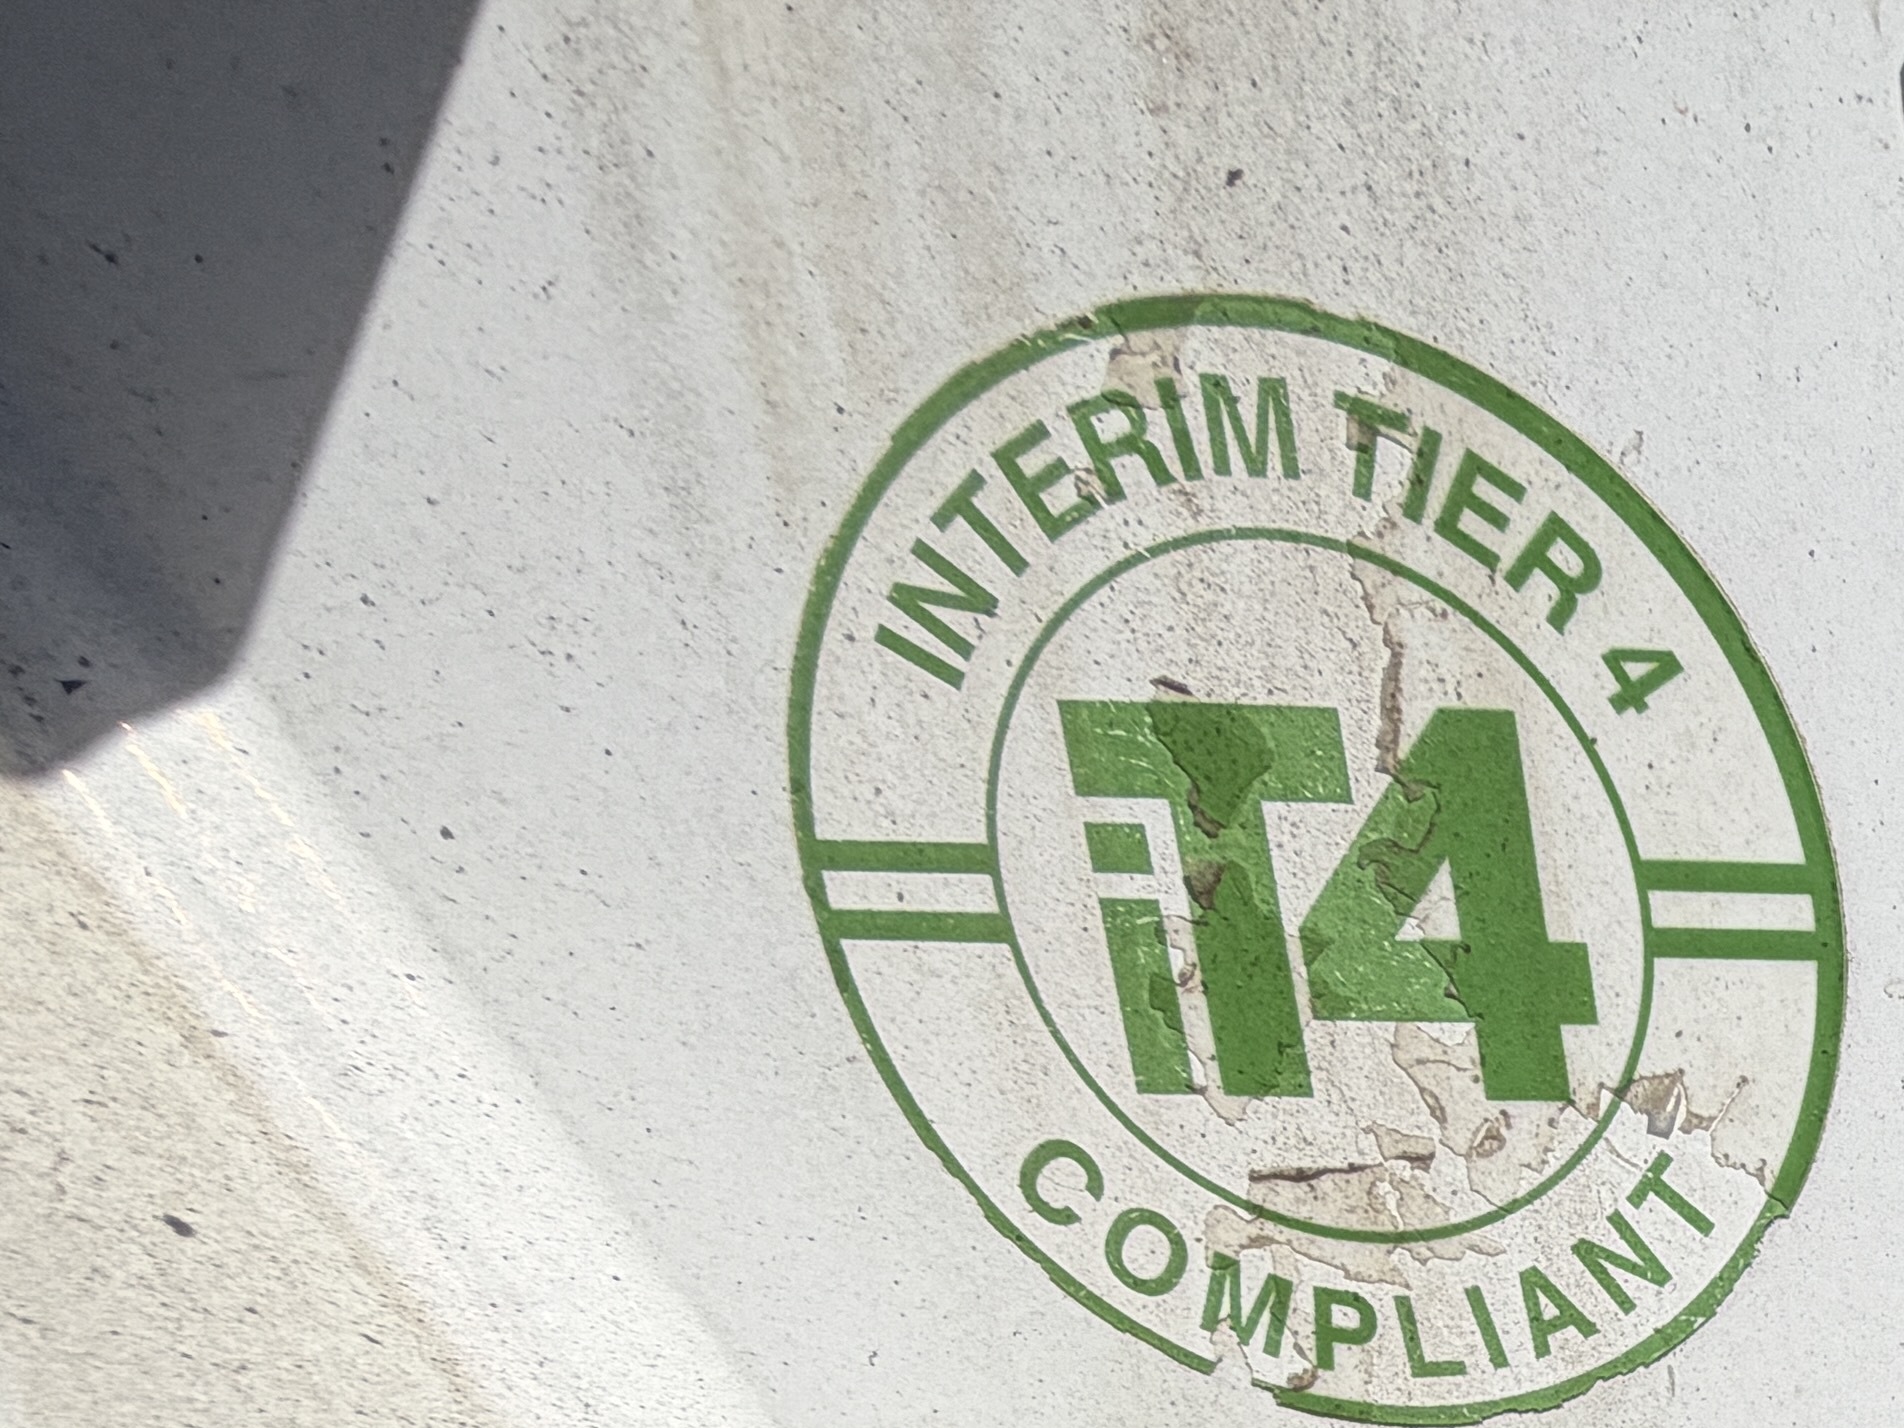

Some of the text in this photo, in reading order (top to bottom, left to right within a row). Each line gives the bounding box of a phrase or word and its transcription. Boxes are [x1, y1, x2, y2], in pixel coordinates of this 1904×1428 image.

[874, 373, 1684, 716] INTERIM TIER 4
[1018, 1137, 1716, 1378] COMPLIANT
